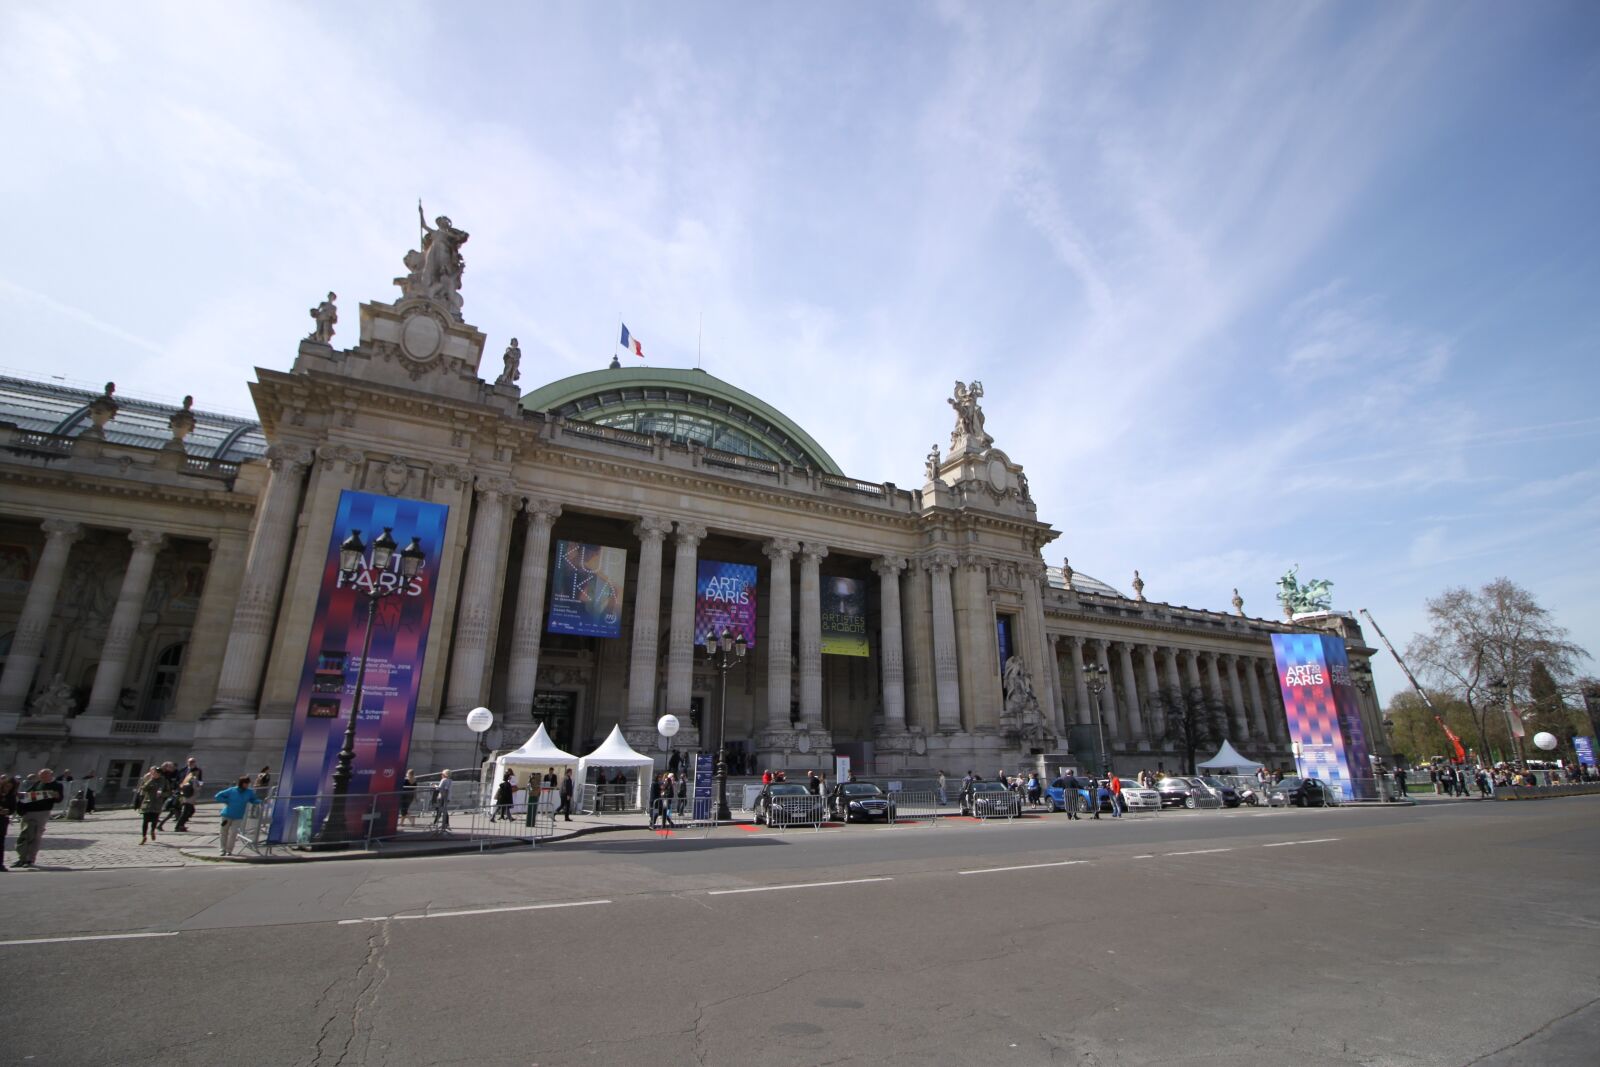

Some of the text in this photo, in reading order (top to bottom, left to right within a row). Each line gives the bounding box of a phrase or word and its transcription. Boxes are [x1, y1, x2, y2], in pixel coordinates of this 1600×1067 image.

[708, 576, 739, 591] ART
[705, 588, 749, 605] PARIS
[822, 613, 865, 625] ARTISTES
[832, 622, 865, 634] ROBOTS
[1287, 664, 1311, 677] ART
[1285, 673, 1324, 687] PARIS
